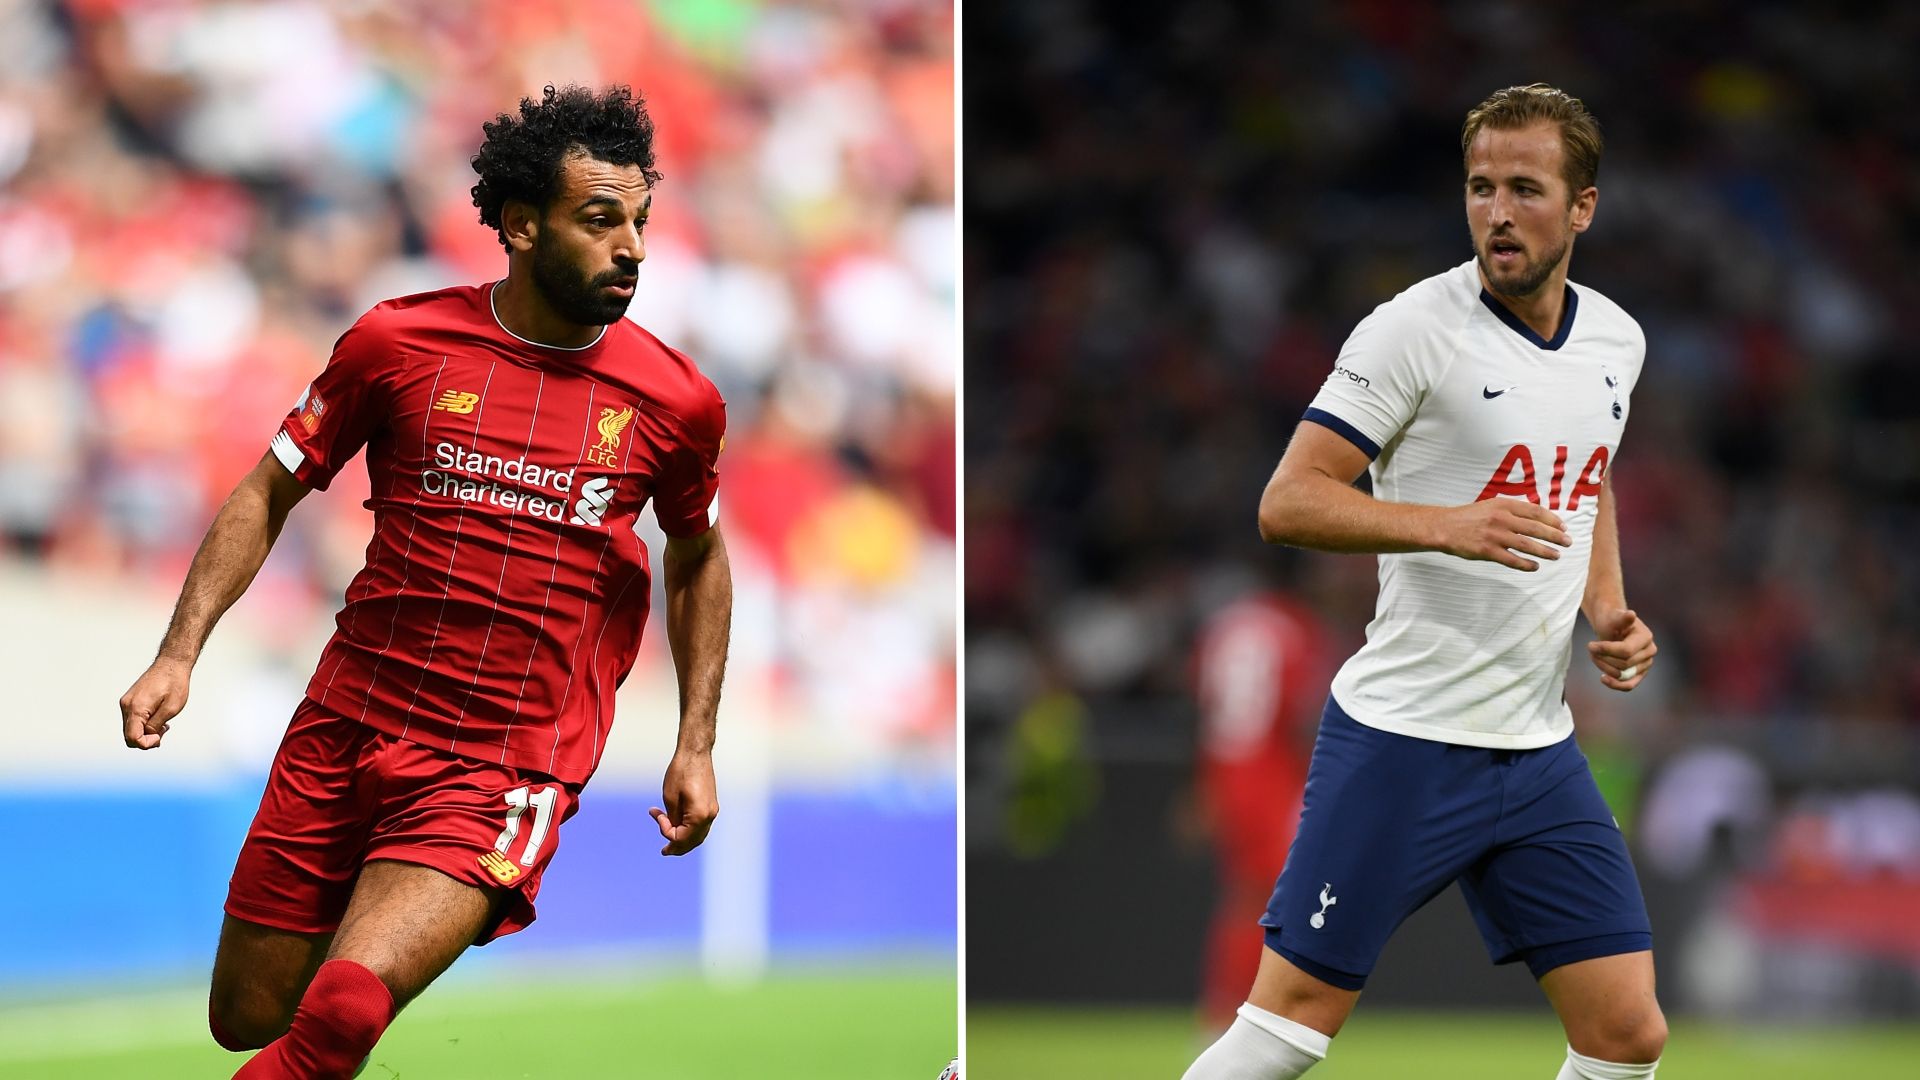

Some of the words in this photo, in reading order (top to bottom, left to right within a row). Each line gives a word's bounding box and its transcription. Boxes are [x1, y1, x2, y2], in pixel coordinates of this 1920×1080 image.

[422, 469, 567, 523] Chartered
[435, 442, 575, 493] Standard
[1474, 444, 1609, 511] AIA
[494, 786, 557, 867] 11
